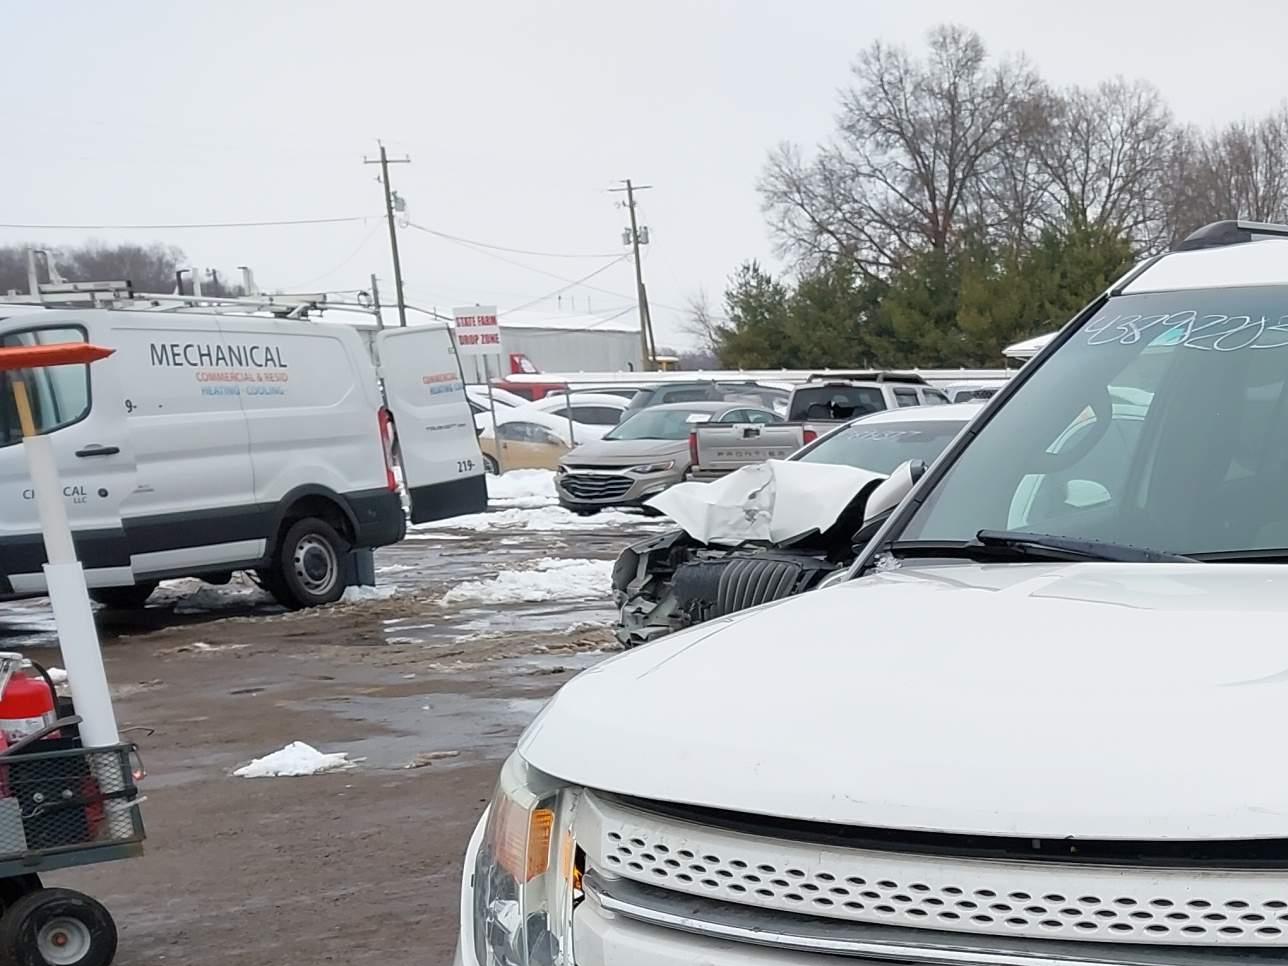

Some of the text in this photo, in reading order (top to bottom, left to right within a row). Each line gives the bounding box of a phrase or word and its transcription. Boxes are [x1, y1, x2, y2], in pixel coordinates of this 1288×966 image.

[456, 315, 497, 327] STATE FARM
[458, 333, 500, 346] DROP ZONE
[150, 343, 288, 368] MECHANICAL
[196, 372, 254, 383] COMMERCIAL
[201, 385, 285, 396] HEATING COOLING
